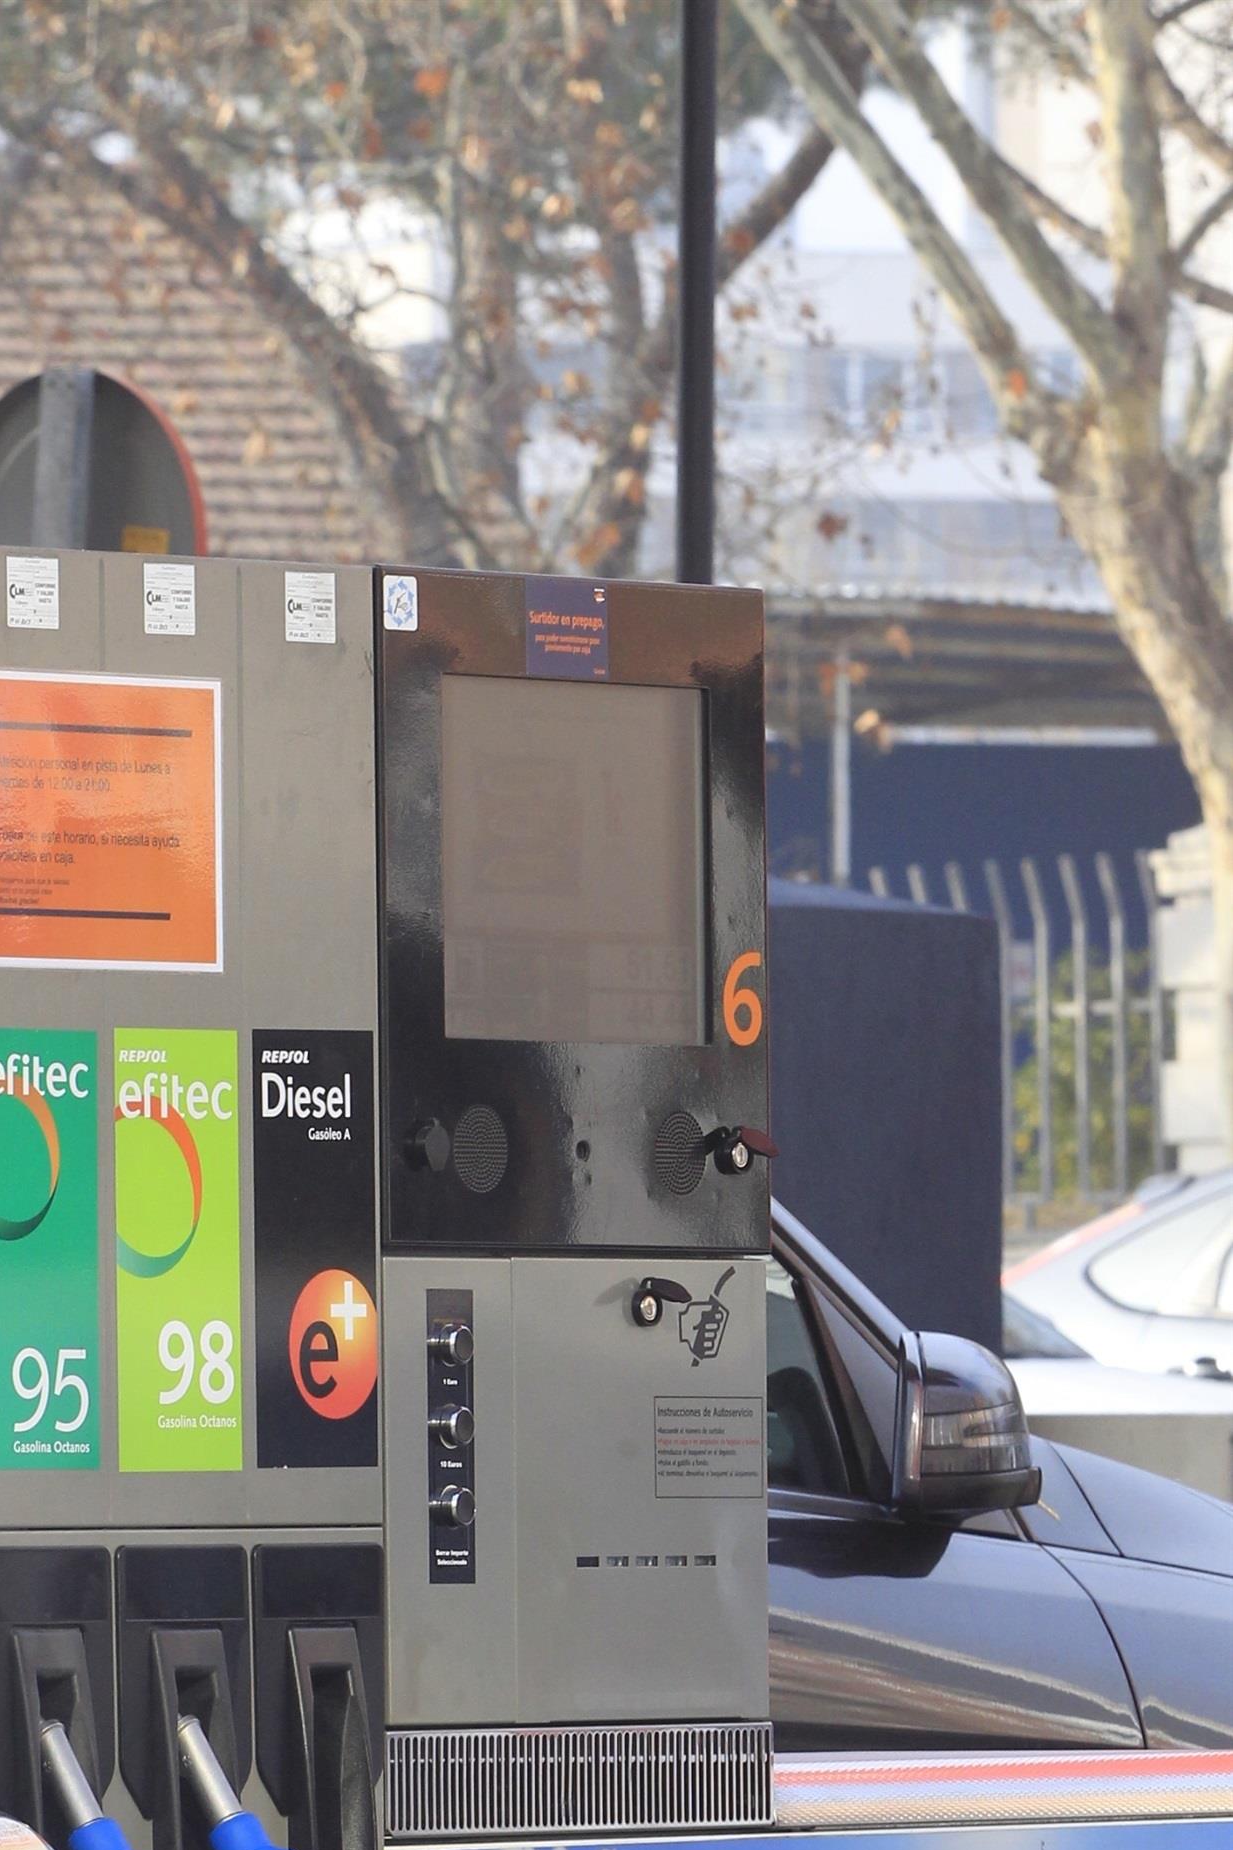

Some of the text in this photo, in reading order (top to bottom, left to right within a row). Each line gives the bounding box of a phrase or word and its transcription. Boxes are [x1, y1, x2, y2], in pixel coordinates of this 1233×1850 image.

[723, 951, 762, 1047] 6
[118, 1049, 168, 1064] REPSOL
[261, 1049, 310, 1065] REPSOL
[118, 1072, 234, 1120] efitec
[261, 1072, 352, 1119] Diesel
[307, 1126, 352, 1142] Gasóleo A
[157, 1319, 235, 1405] 98
[11, 1348, 90, 1433] 95
[713, 1407, 753, 1418] Autoservicio
[157, 1414, 237, 1429] Gasolina Octanos
[13, 1440, 90, 1454] Gasolina Octanos
